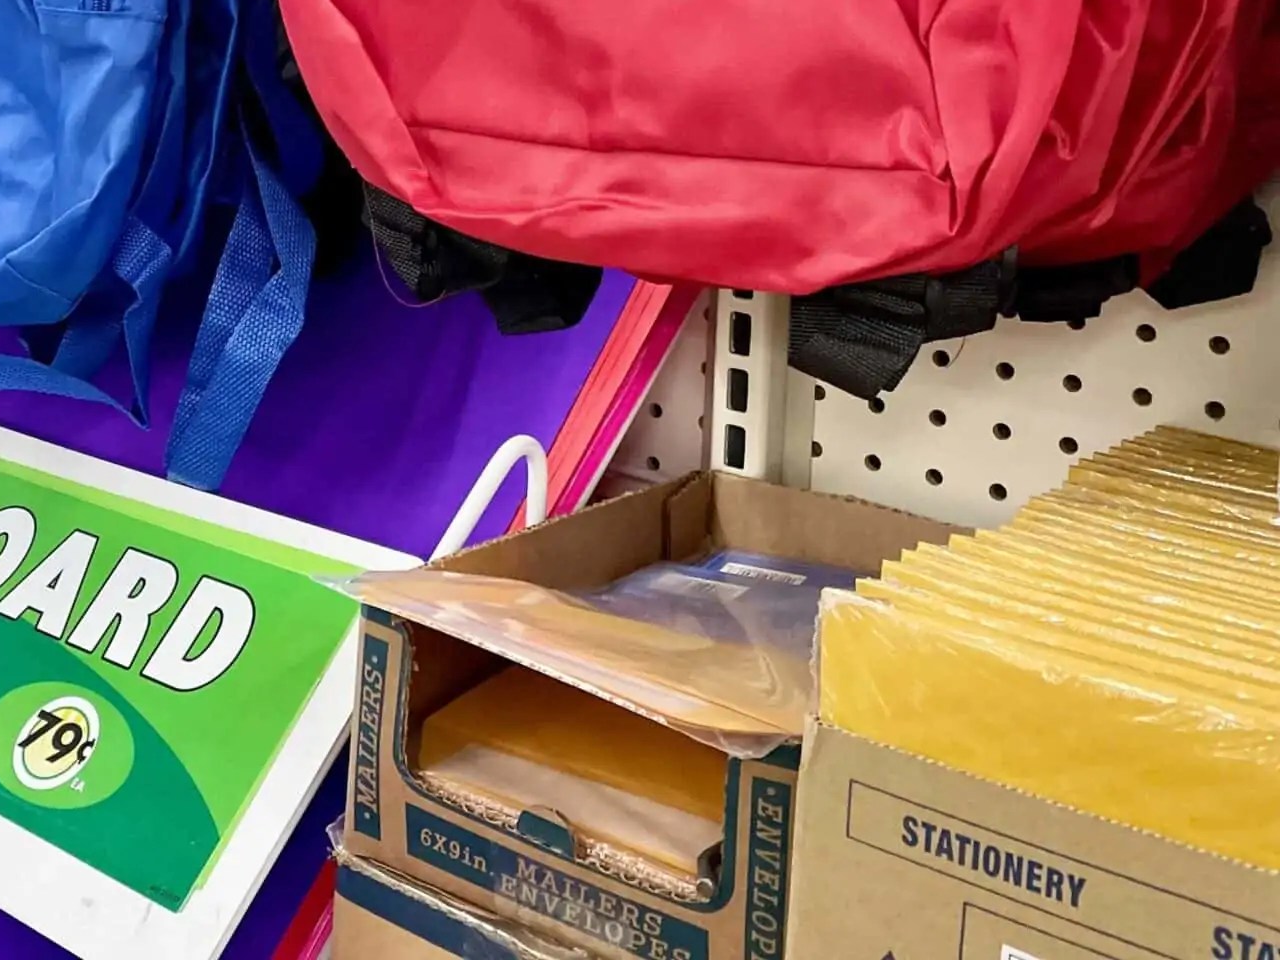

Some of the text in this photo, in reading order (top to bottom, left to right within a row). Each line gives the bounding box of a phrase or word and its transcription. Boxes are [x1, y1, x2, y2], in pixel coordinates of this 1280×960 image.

[356, 664, 383, 814] MAILERS
[516, 857, 663, 937] MAILERS
[901, 815, 1280, 960] STATIONERY STA
